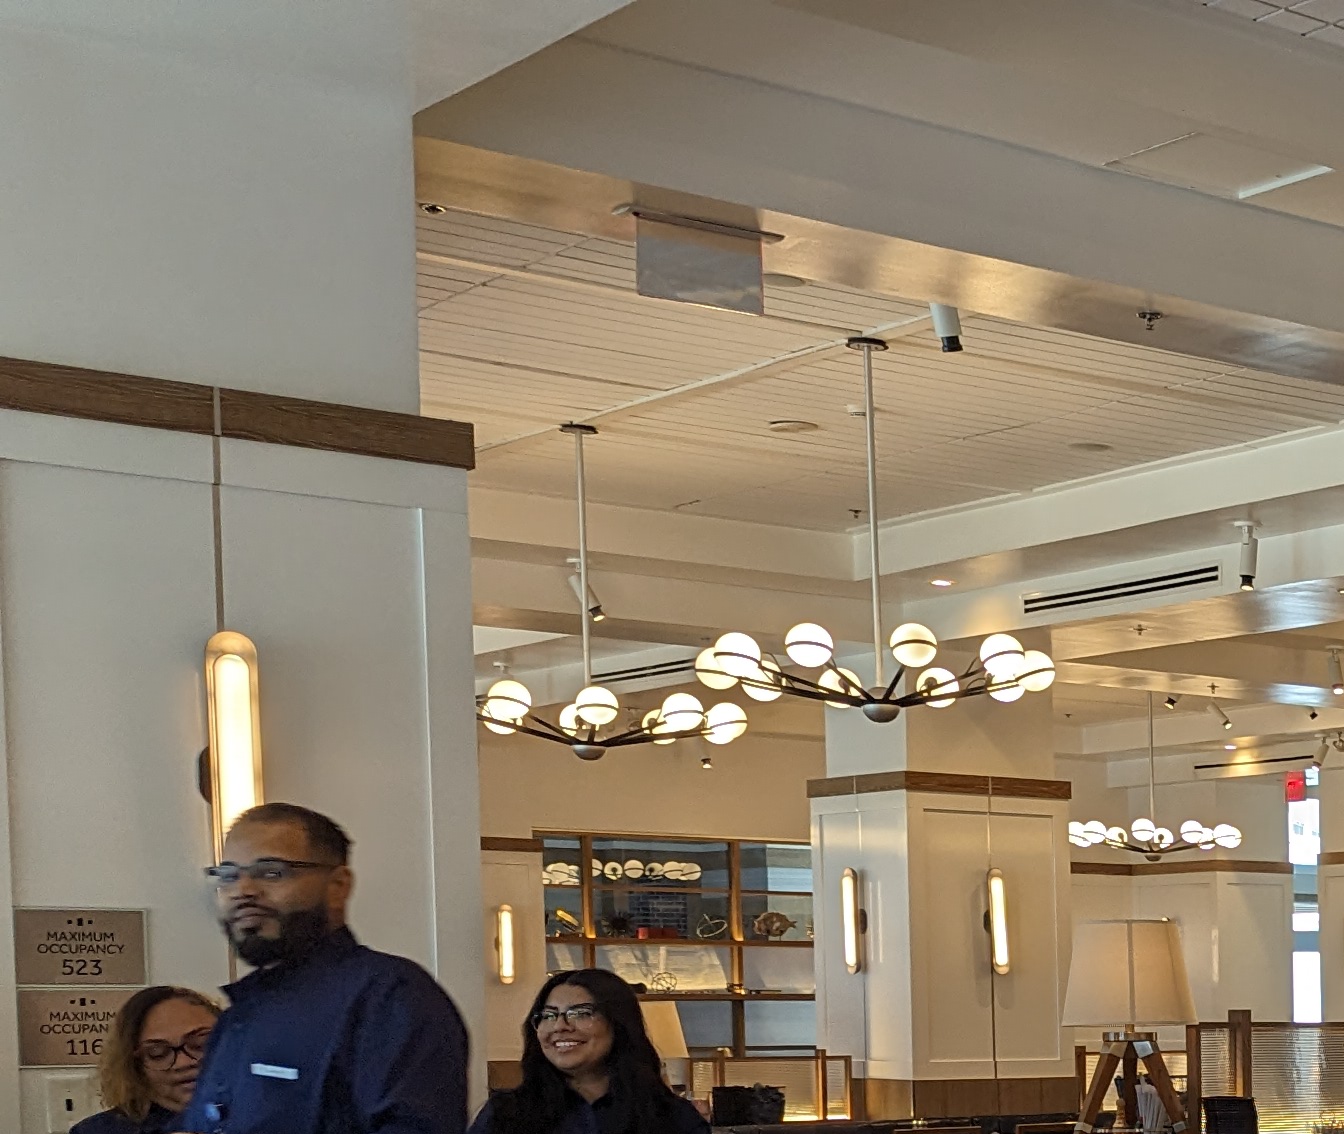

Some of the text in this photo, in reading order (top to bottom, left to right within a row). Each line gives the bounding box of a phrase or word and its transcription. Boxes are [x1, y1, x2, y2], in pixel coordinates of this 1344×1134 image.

[47, 932, 114, 941] MAXIMUM
[37, 944, 125, 954] OCCUPANCY
[62, 959, 102, 975] 523
[50, 1012, 116, 1022] MAXIMUM
[40, 1024, 109, 1034] OCCUPAN
[67, 1039, 103, 1055] 116
